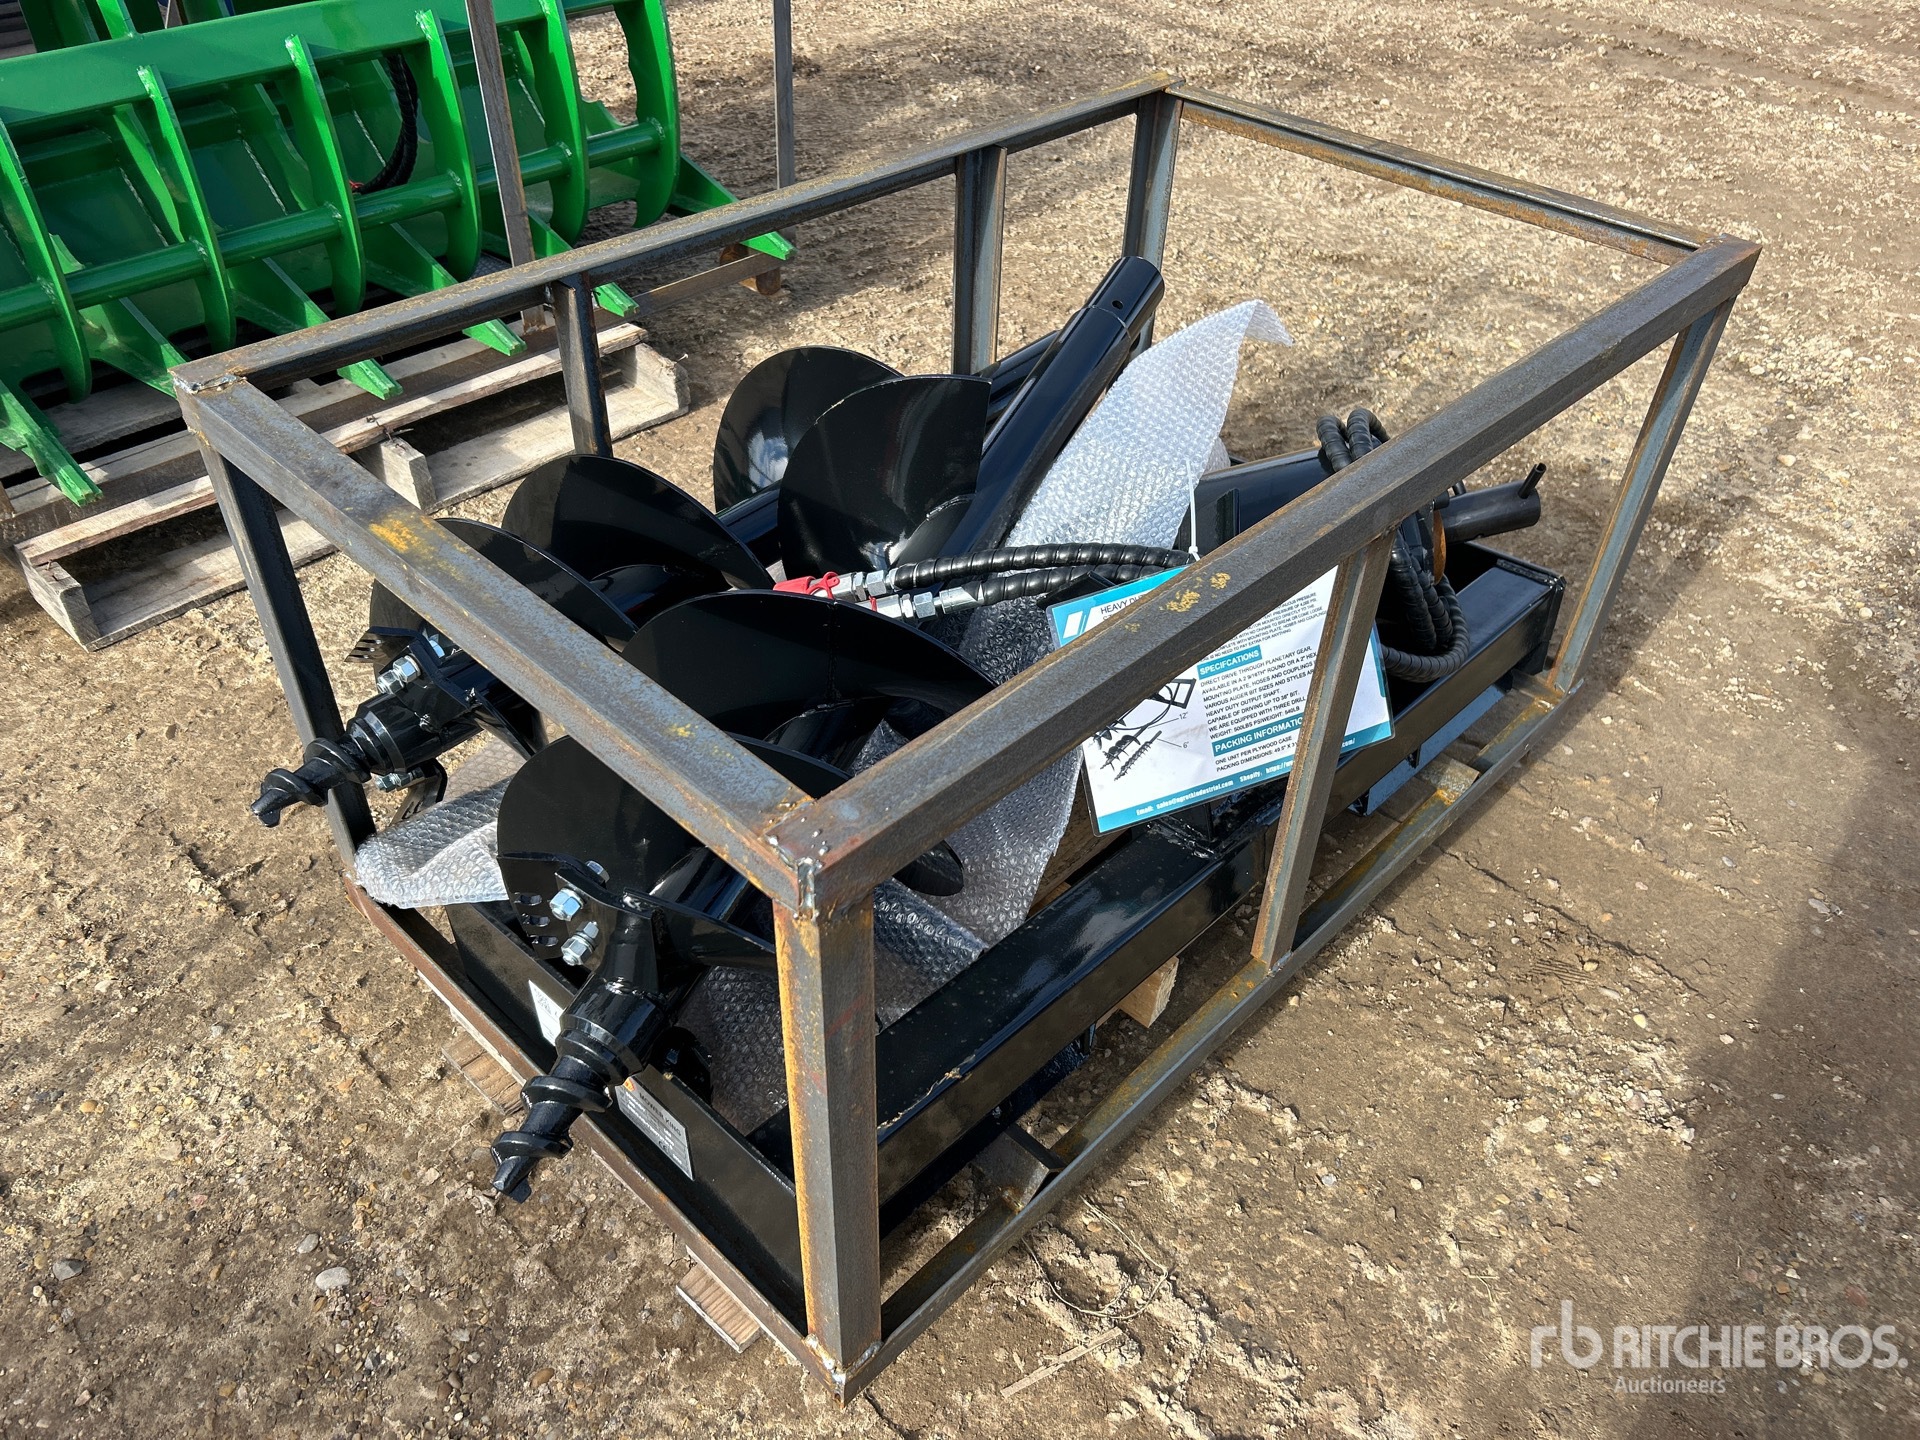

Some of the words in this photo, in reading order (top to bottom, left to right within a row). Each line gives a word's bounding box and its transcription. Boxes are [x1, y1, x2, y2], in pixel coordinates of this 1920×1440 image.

[1100, 599, 1128, 614] HEAVY
[1262, 616, 1281, 625] MOUNTED
[1282, 609, 1300, 618] DIRECTLY
[1200, 649, 1259, 676] SPECIFCATIONS
[1201, 677, 1220, 687] DIRECT
[1222, 671, 1237, 680] DRIVE
[1239, 662, 1264, 674] THROUGH
[1266, 651, 1295, 665] PLANETARY
[1202, 682, 1230, 695] AVAILABLE
[1268, 662, 1286, 673] ROUND
[1204, 689, 1232, 702] MOUNTING
[1252, 676, 1270, 686] HOSES
[1283, 661, 1312, 676] COUPLINGS
[1205, 698, 1228, 710] VARIOUS
[1230, 692, 1248, 702] AUGER
[1259, 683, 1273, 692] SIZES
[1287, 672, 1306, 682] STYLES
[1207, 708, 1224, 718] HEAVY
[1225, 702, 1240, 711] DUTY
[1241, 695, 1262, 706] OUTPUT
[1208, 713, 1232, 725] CAPABLE
[1242, 702, 1263, 714] DRIVING
[1231, 712, 1257, 725] EQUIPPED
[1259, 707, 1272, 716] WITH
[1273, 701, 1290, 711] THREE
[1292, 696, 1306, 705] DRILL
[1216, 734, 1252, 752] PACKING
[1252, 741, 1277, 753] PLYWOOD
[1279, 736, 1292, 744] CASE
[1217, 761, 1239, 772] PACKING
